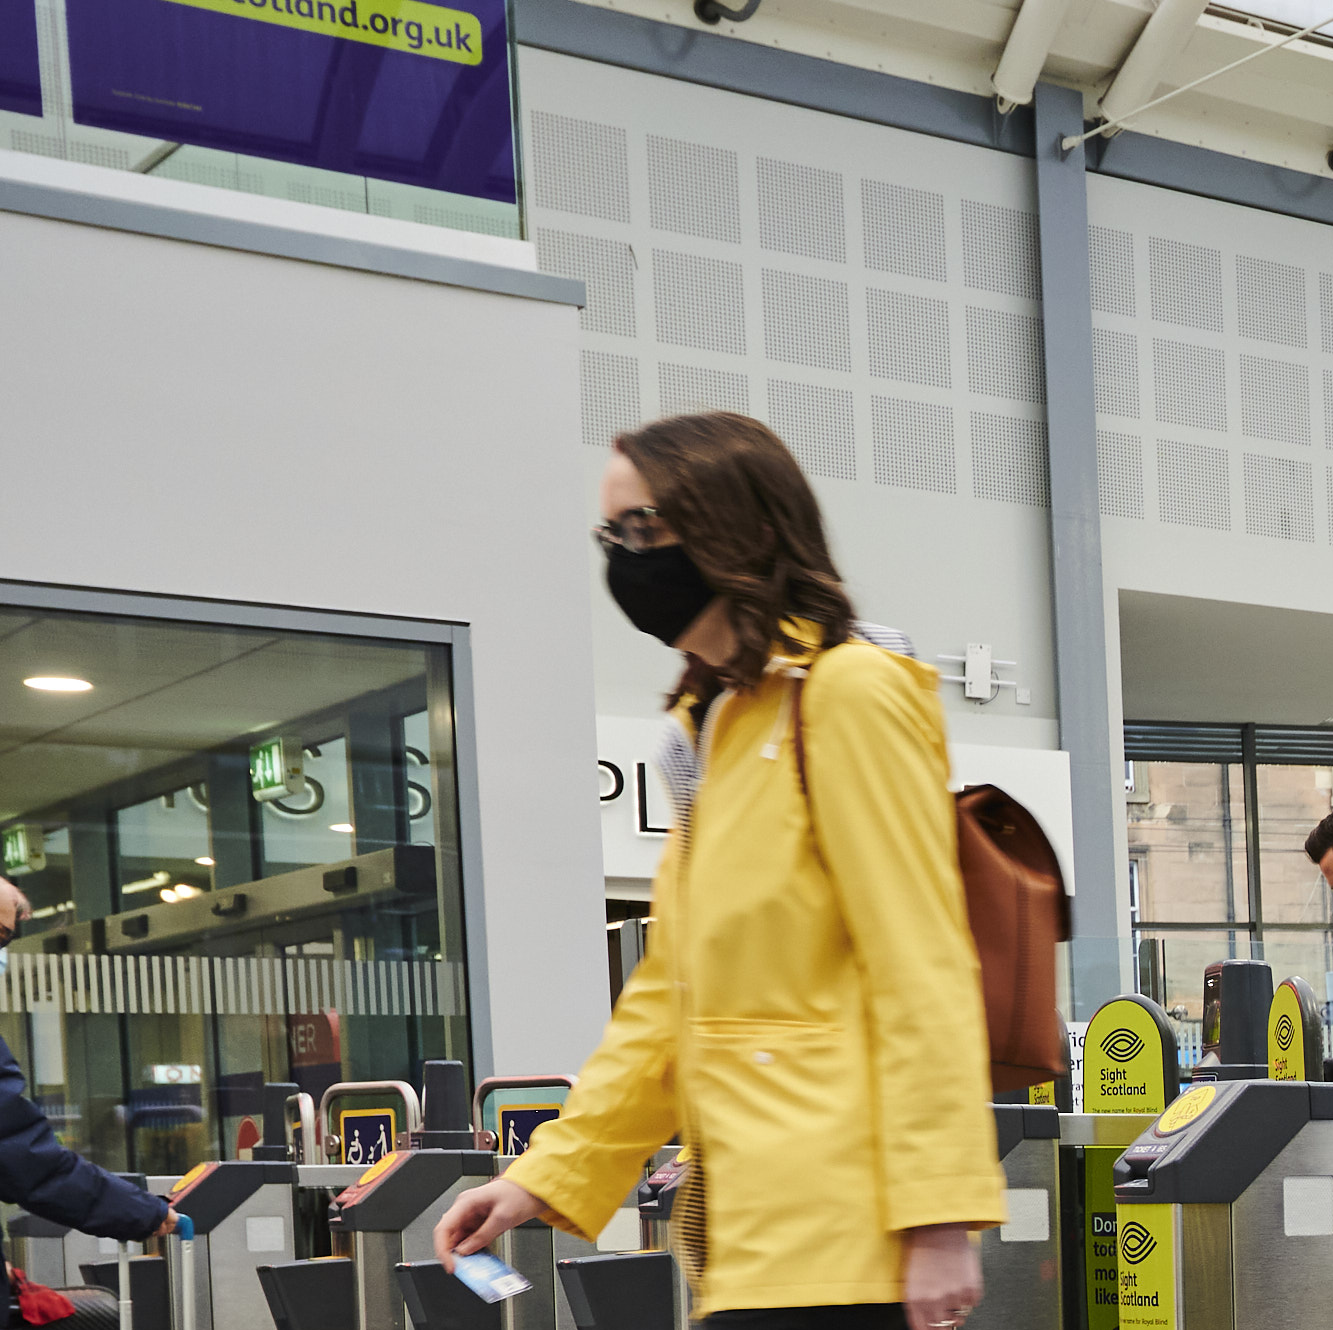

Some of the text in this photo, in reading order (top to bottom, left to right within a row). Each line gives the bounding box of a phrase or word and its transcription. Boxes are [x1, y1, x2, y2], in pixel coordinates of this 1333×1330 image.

[1100, 1067, 1127, 1084] Sight
[1100, 1082, 1147, 1096] Scotland
[1120, 1291, 1160, 1307] Scotland
